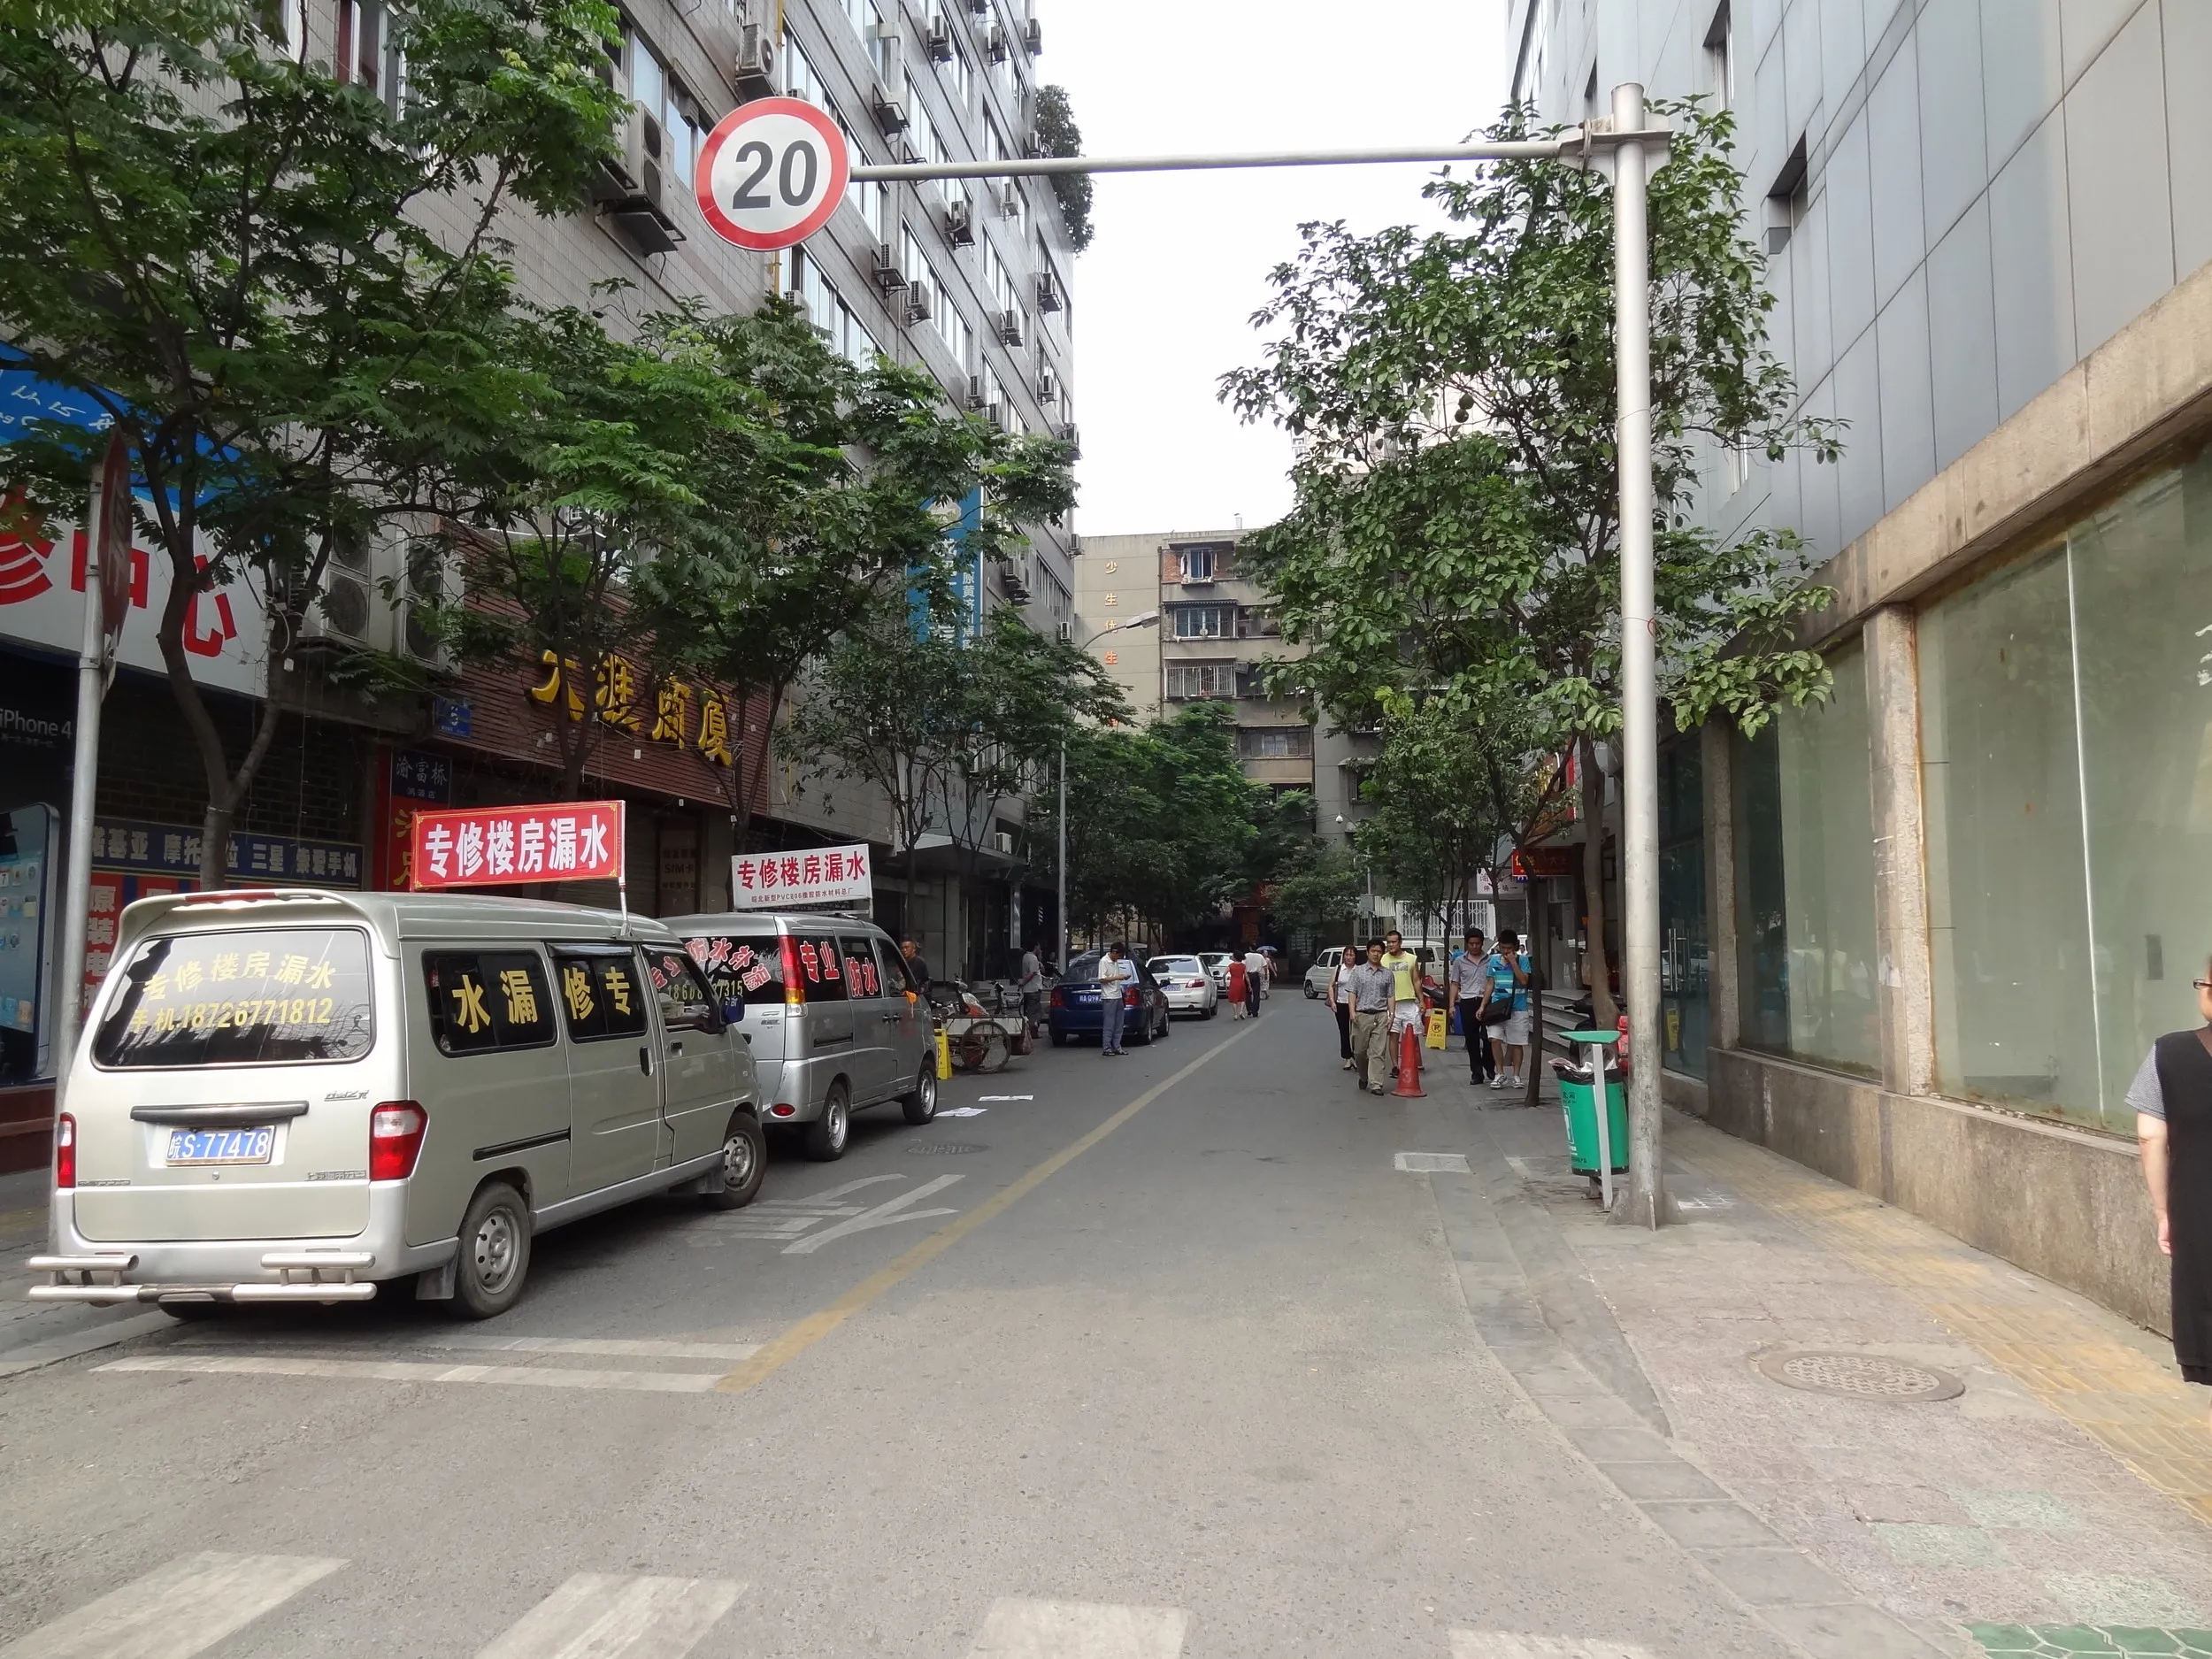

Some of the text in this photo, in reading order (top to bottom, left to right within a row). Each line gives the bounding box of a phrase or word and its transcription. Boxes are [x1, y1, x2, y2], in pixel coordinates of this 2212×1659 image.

[732, 139, 818, 210] 20
[0, 707, 73, 740] iPhone 4
[396, 754, 448, 787] 渝富桥
[164, 833, 239, 869] 摩托拉
[251, 843, 284, 872] 三星
[296, 847, 357, 879] 索爱手机
[425, 814, 610, 879] 专修楼房漏水
[737, 850, 866, 890] 专修楼房漏水
[142, 950, 337, 1002] 专修楼房漏水
